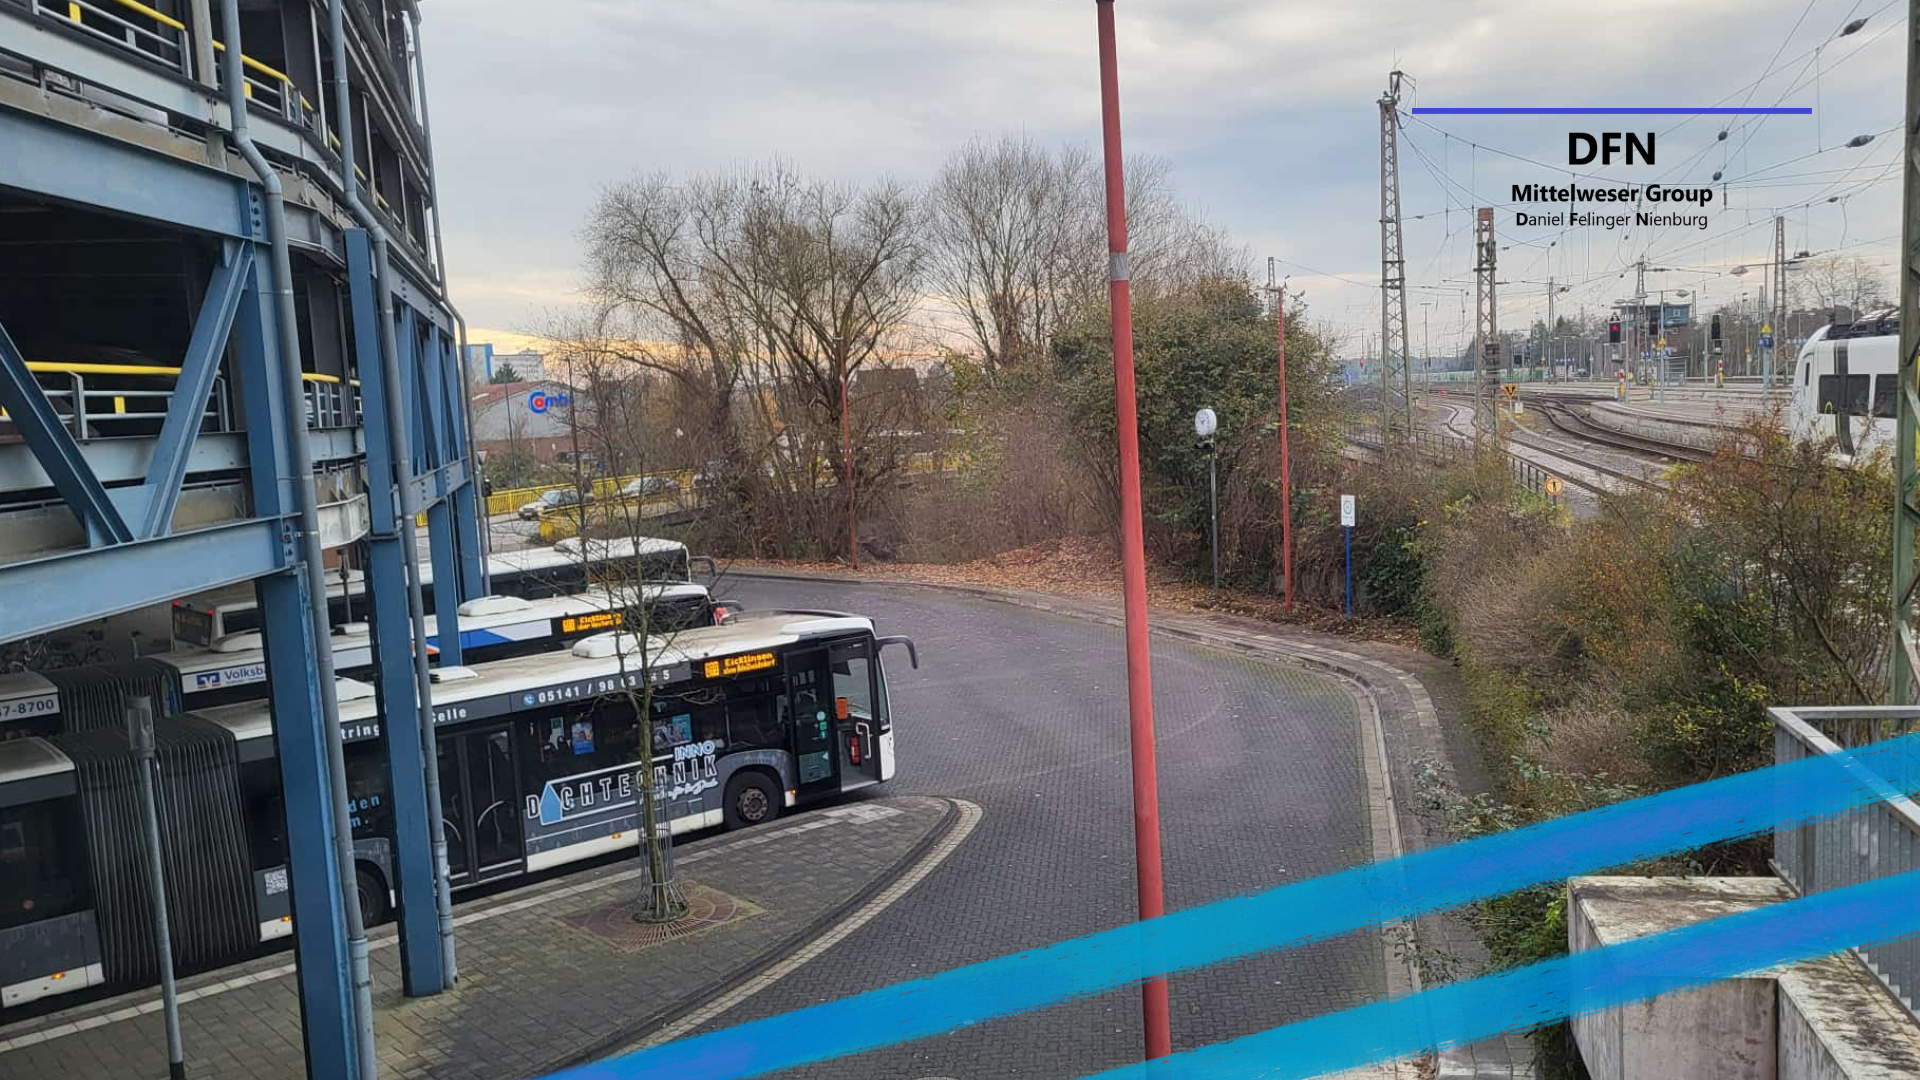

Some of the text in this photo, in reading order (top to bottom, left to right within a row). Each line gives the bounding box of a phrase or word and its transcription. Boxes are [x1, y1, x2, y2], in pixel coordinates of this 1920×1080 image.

[224, 666, 264, 680] Volksb
[538, 687, 580, 704] 05141
[599, 678, 614, 692] 98
[0, 699, 54, 718] 7-8700
[674, 740, 716, 761] INNO
